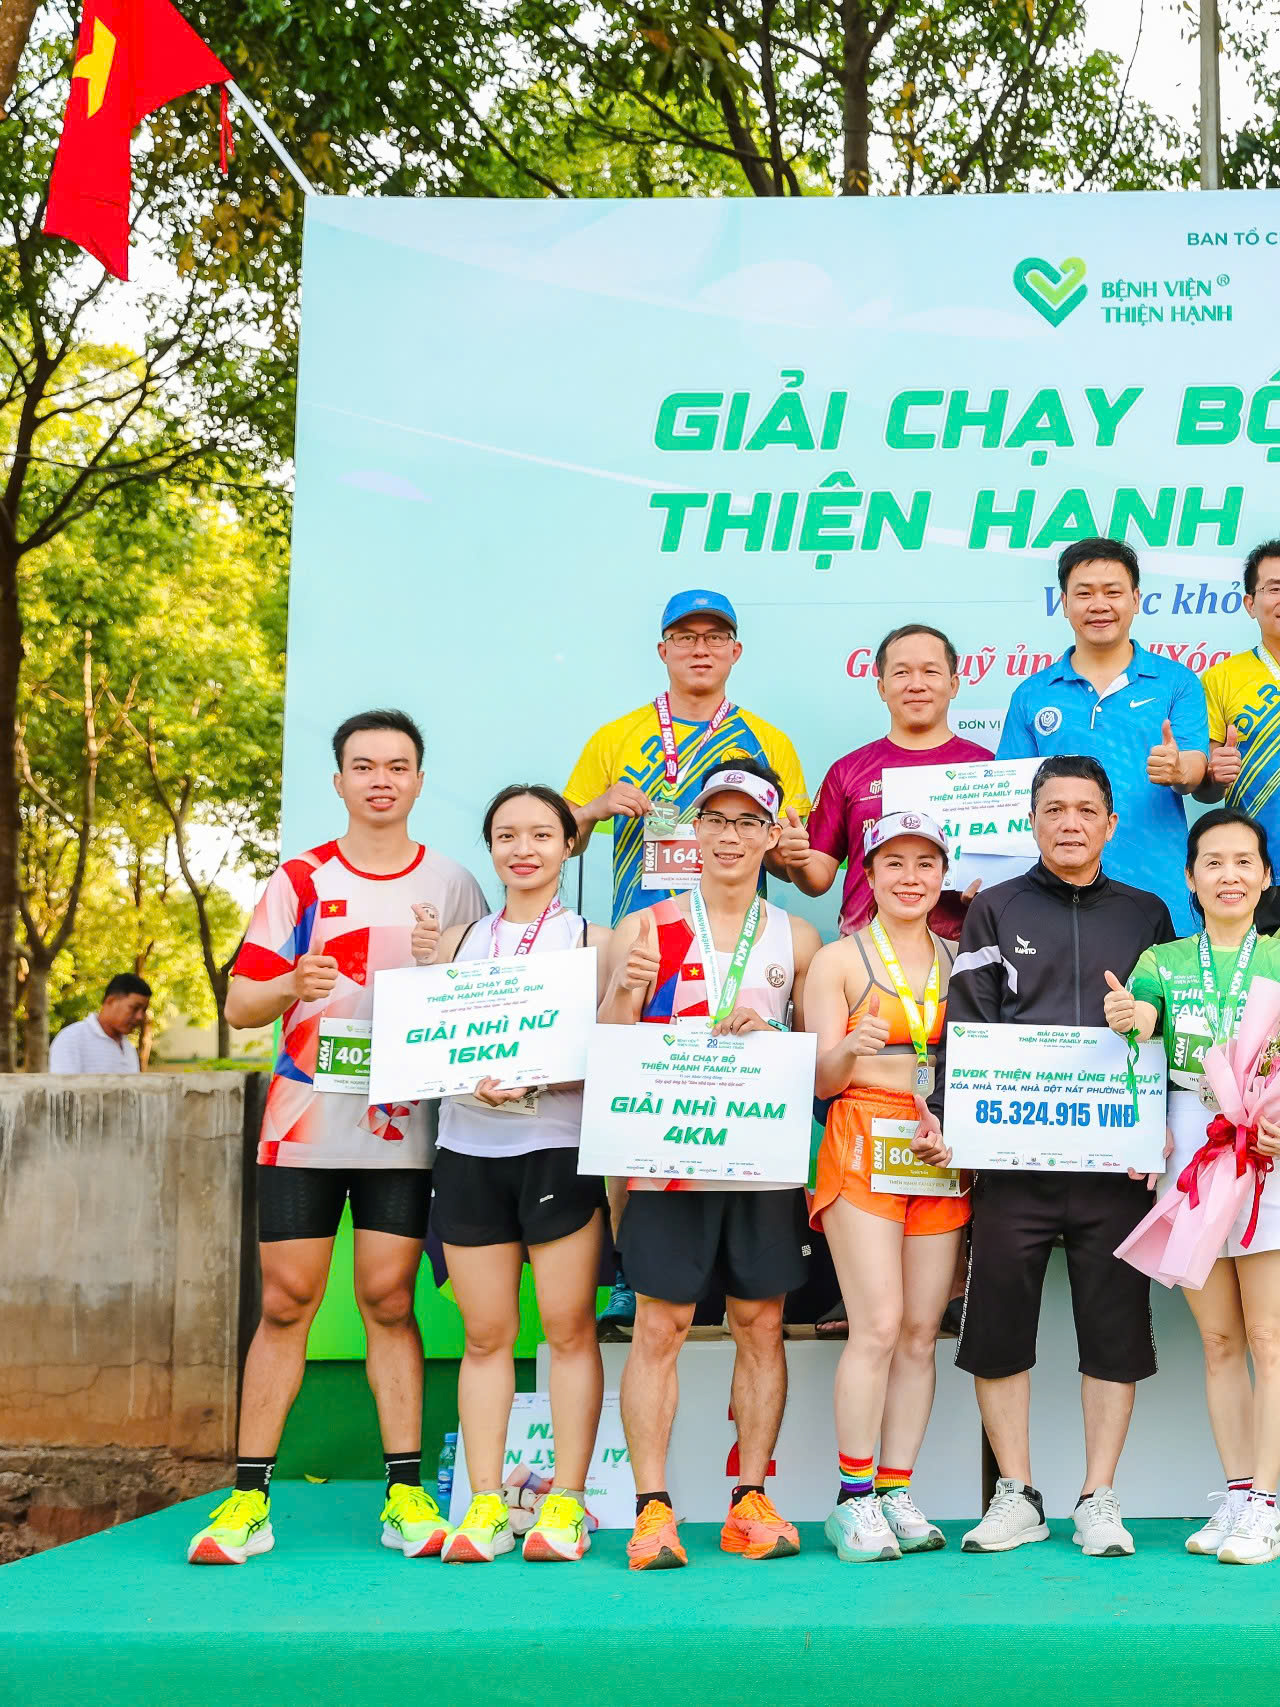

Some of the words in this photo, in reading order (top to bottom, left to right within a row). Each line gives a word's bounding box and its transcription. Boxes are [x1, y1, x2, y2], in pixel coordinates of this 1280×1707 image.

[1187, 232, 1228, 246] BAN
[1234, 227, 1260, 246] TỔ
[1101, 276, 1158, 300] BỆNH
[1163, 277, 1212, 301] VIỆN
[1101, 301, 1165, 328] THIỆN
[1170, 304, 1233, 326] HẠNH
[653, 369, 848, 452] GIẢI
[885, 387, 1145, 467] CHẠY
[649, 470, 932, 571] THIỆN
[1170, 580, 1244, 617] khỏ
[957, 645, 997, 685] uỹ
[958, 719, 986, 731] ĐƠN
[982, 789, 1012, 798] FAMILY
[968, 821, 998, 836] BA
[645, 842, 655, 872] 16KM
[734, 939, 750, 968] 4KM
[426, 993, 454, 1004] THIỆN
[487, 986, 521, 998] FAMILY
[523, 984, 544, 993] RUN
[454, 981, 474, 992] GIẢI
[476, 979, 501, 990] CHẠY
[1202, 970, 1214, 993] 4KM
[1229, 970, 1243, 996] 4KM
[406, 1021, 457, 1044] GIẢI
[466, 1015, 509, 1037] NHÌ
[519, 1009, 560, 1032] NỮ
[318, 1039, 330, 1071] 4KM
[448, 1041, 519, 1065] 16KM
[670, 1051, 690, 1061] GIẢI
[692, 1054, 719, 1064] CHẠY
[721, 1054, 736, 1065] BỘ
[1173, 1036, 1186, 1067] 4KM
[641, 1061, 670, 1072] THIỆN
[672, 1063, 700, 1073] HẠNH
[703, 1065, 737, 1073] FAMILY
[740, 1066, 761, 1075] RUN
[951, 1068, 988, 1079] BVĐK
[993, 1068, 1031, 1081] THIỆN
[1035, 1071, 1073, 1083] HẠNH
[1077, 1070, 1105, 1082] ỦNG
[950, 1082, 969, 1090] XÓA
[972, 1082, 992, 1091] NHÀ
[1020, 1083, 1040, 1092] NHÀ
[1043, 1085, 1062, 1095] DỘT
[1065, 1084, 1084, 1093] NÁT
[1086, 1086, 1125, 1096] PHƯỜNG
[610, 1091, 664, 1114] GIẢI
[672, 1096, 717, 1118] NHÌ
[726, 1101, 787, 1119] NAM
[975, 1099, 1090, 1126] 85.324.915
[1098, 1103, 1136, 1128] VNĐ
[663, 1125, 728, 1146] 4KM
[873, 1140, 883, 1170] 8KM
